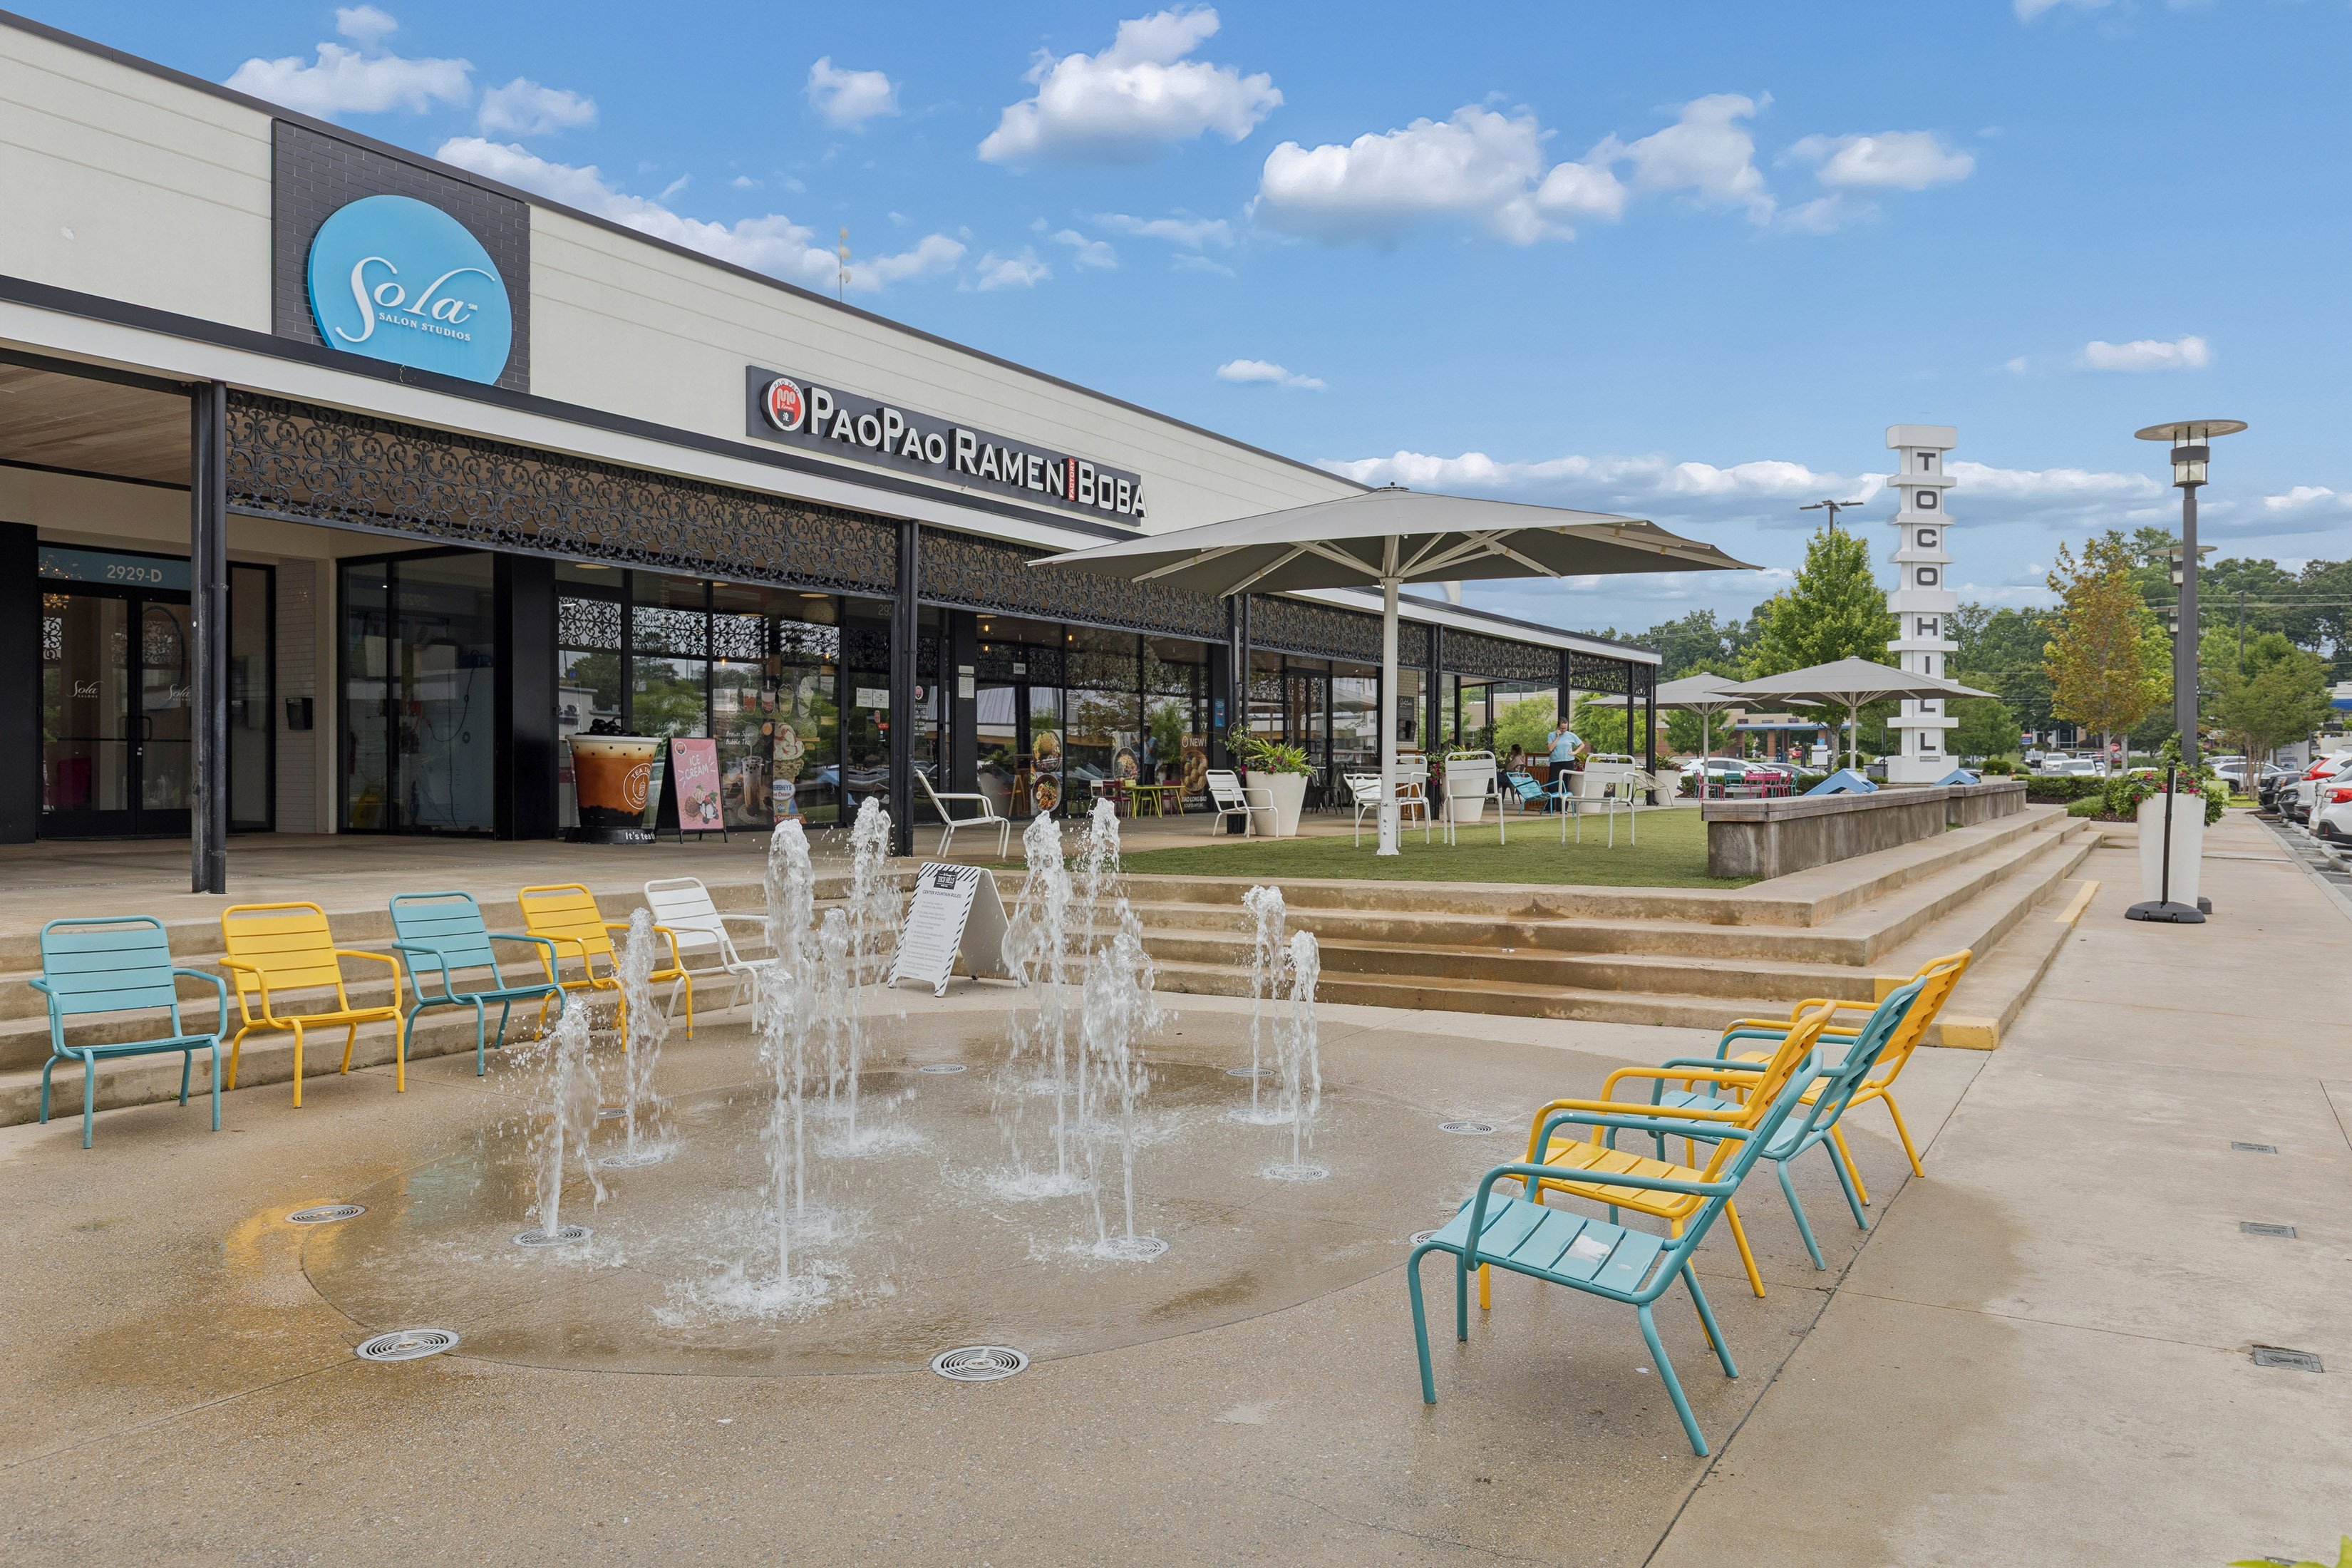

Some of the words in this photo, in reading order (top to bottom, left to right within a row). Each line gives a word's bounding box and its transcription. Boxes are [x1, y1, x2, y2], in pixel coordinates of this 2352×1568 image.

[335, 256, 495, 343] Sola
[378, 312, 418, 329] SALON
[421, 323, 470, 341] STUDIOS
[955, 428, 1064, 496] RAMEN
[1078, 460, 1149, 519] BOBA
[1917, 452, 1938, 587] TOCO
[107, 564, 163, 583] 2929-D
[66, 680, 105, 698] Sola
[163, 684, 192, 701] Sola
[1190, 738, 1207, 747] NEW!
[688, 755, 701, 767] ICE
[631, 768, 643, 778] TEA
[684, 763, 709, 780] CREAM
[625, 831, 640, 840] It's
